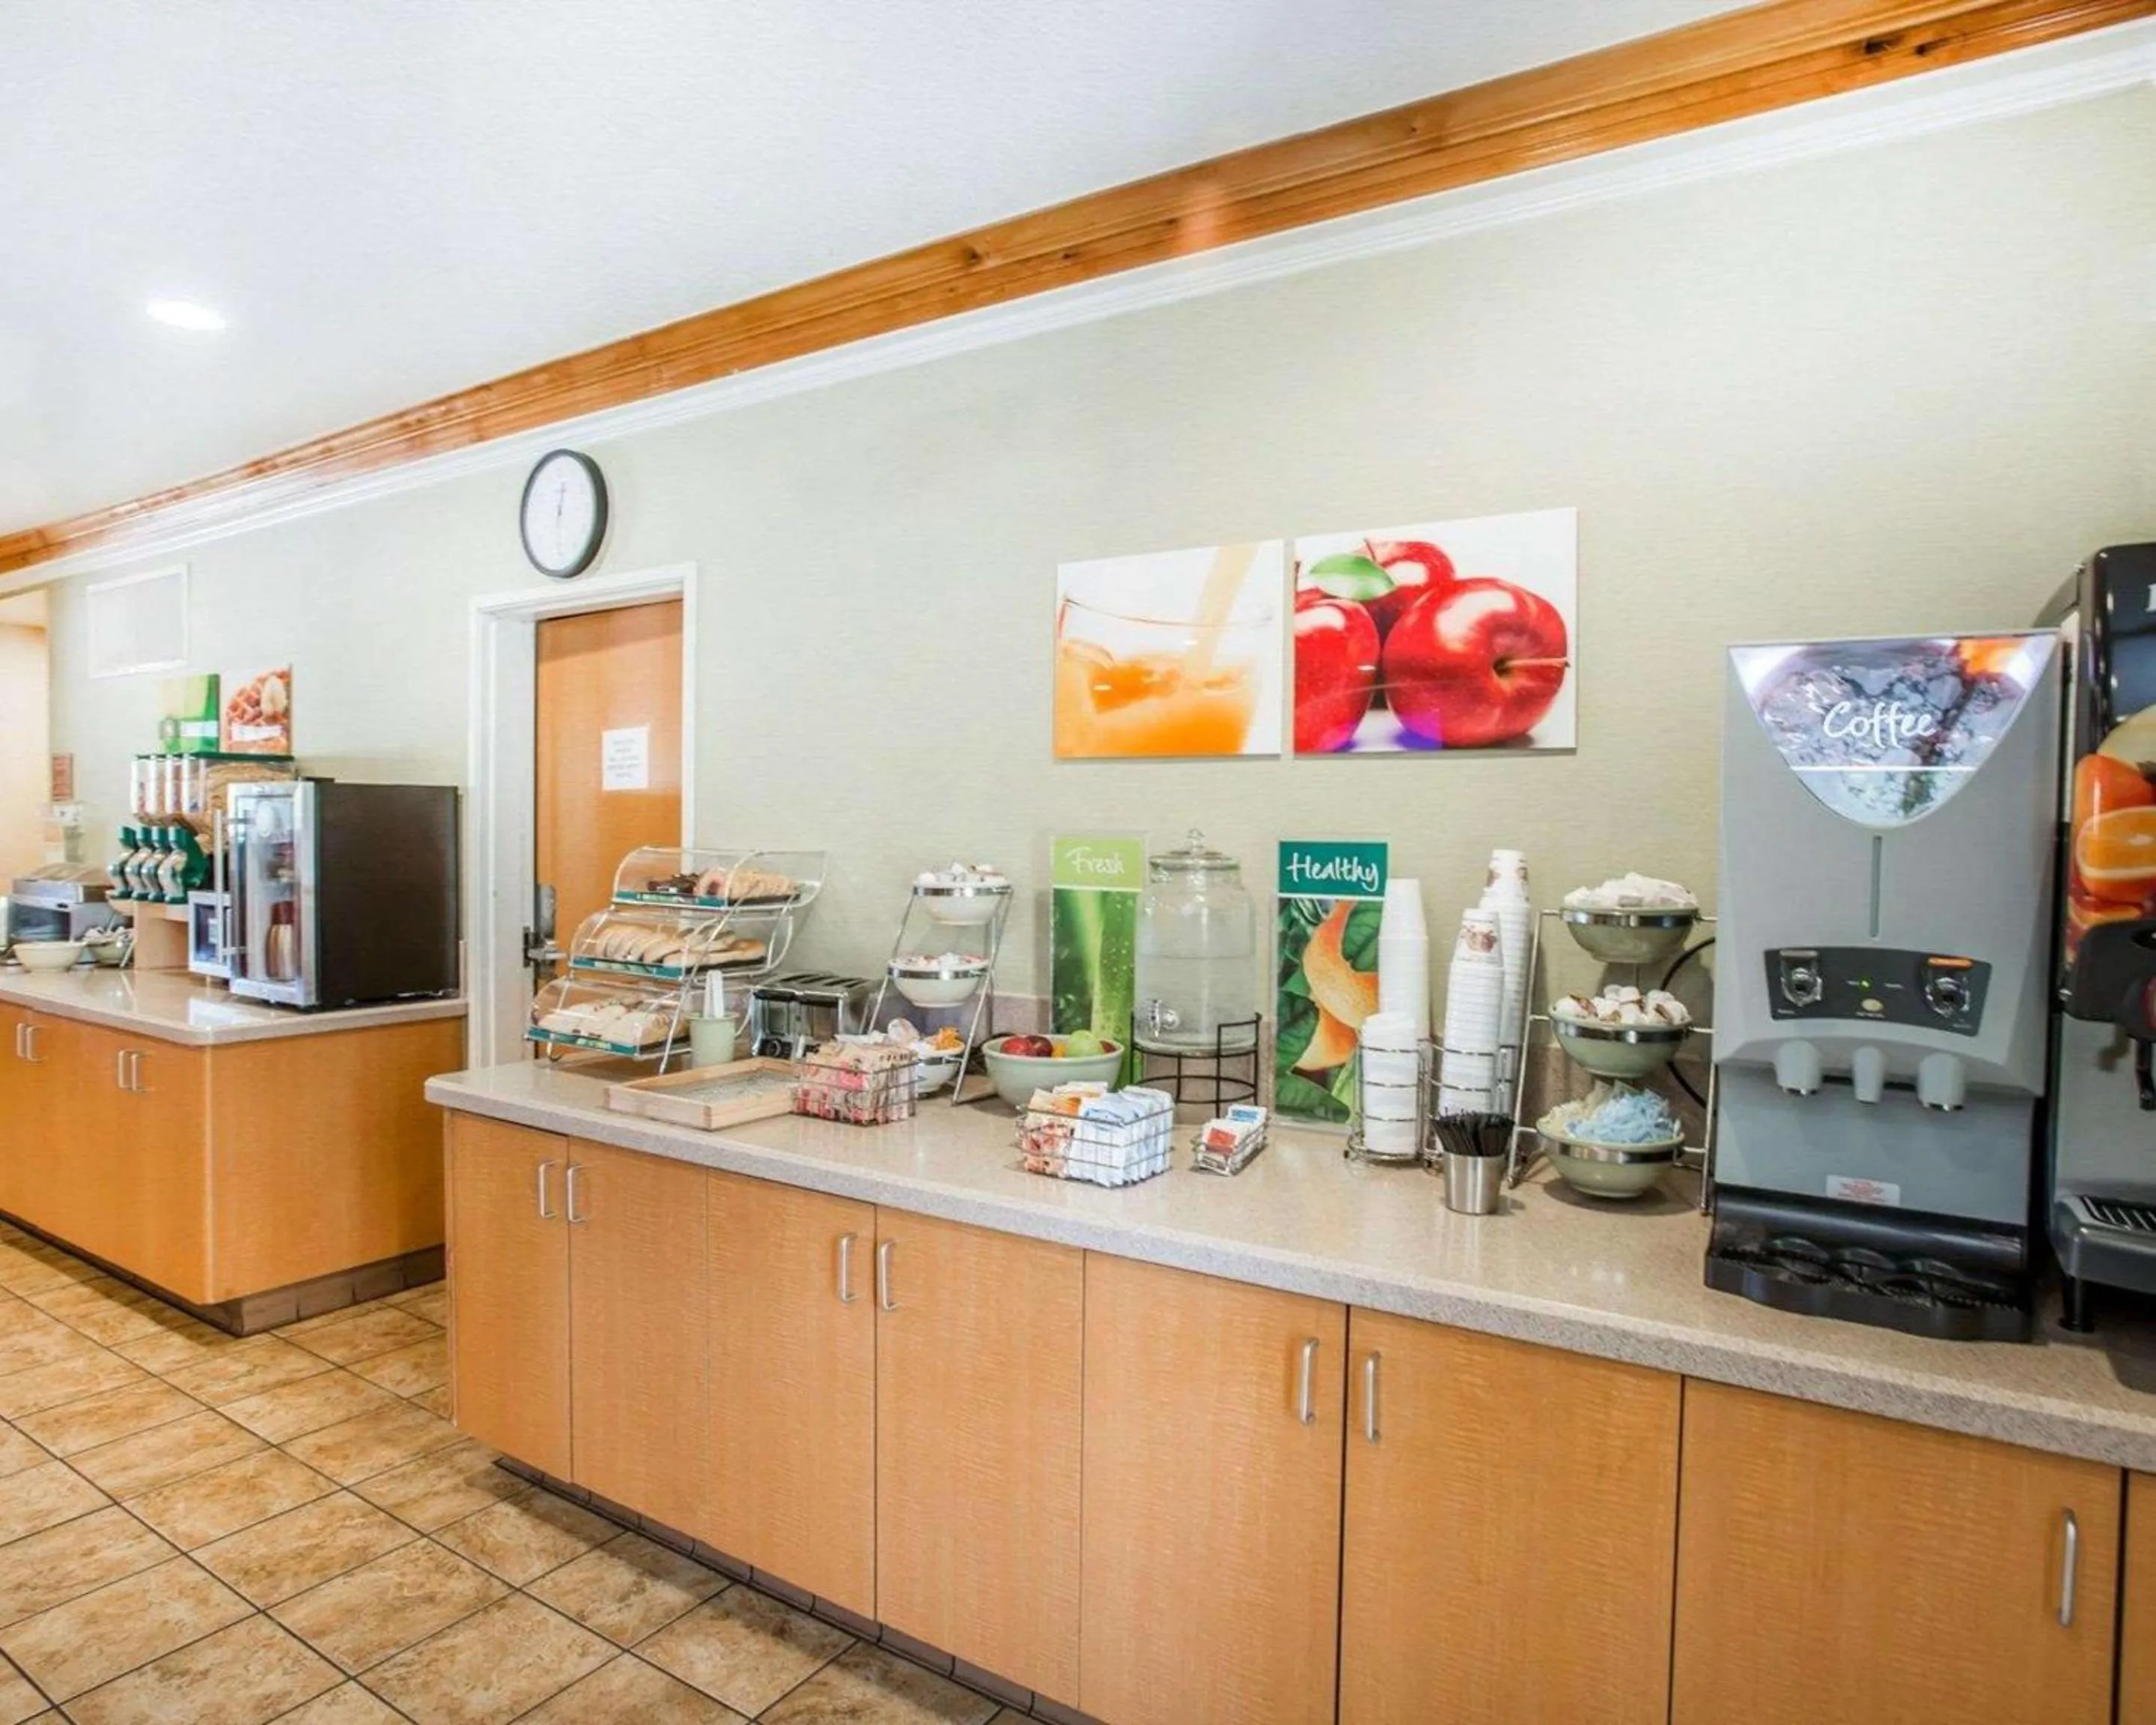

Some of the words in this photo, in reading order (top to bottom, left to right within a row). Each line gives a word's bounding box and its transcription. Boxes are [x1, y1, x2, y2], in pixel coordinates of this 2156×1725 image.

[1824, 701, 1937, 749] Coffee
[1065, 845, 1125, 874] Fresh
[1285, 852, 1378, 892] Healthy
